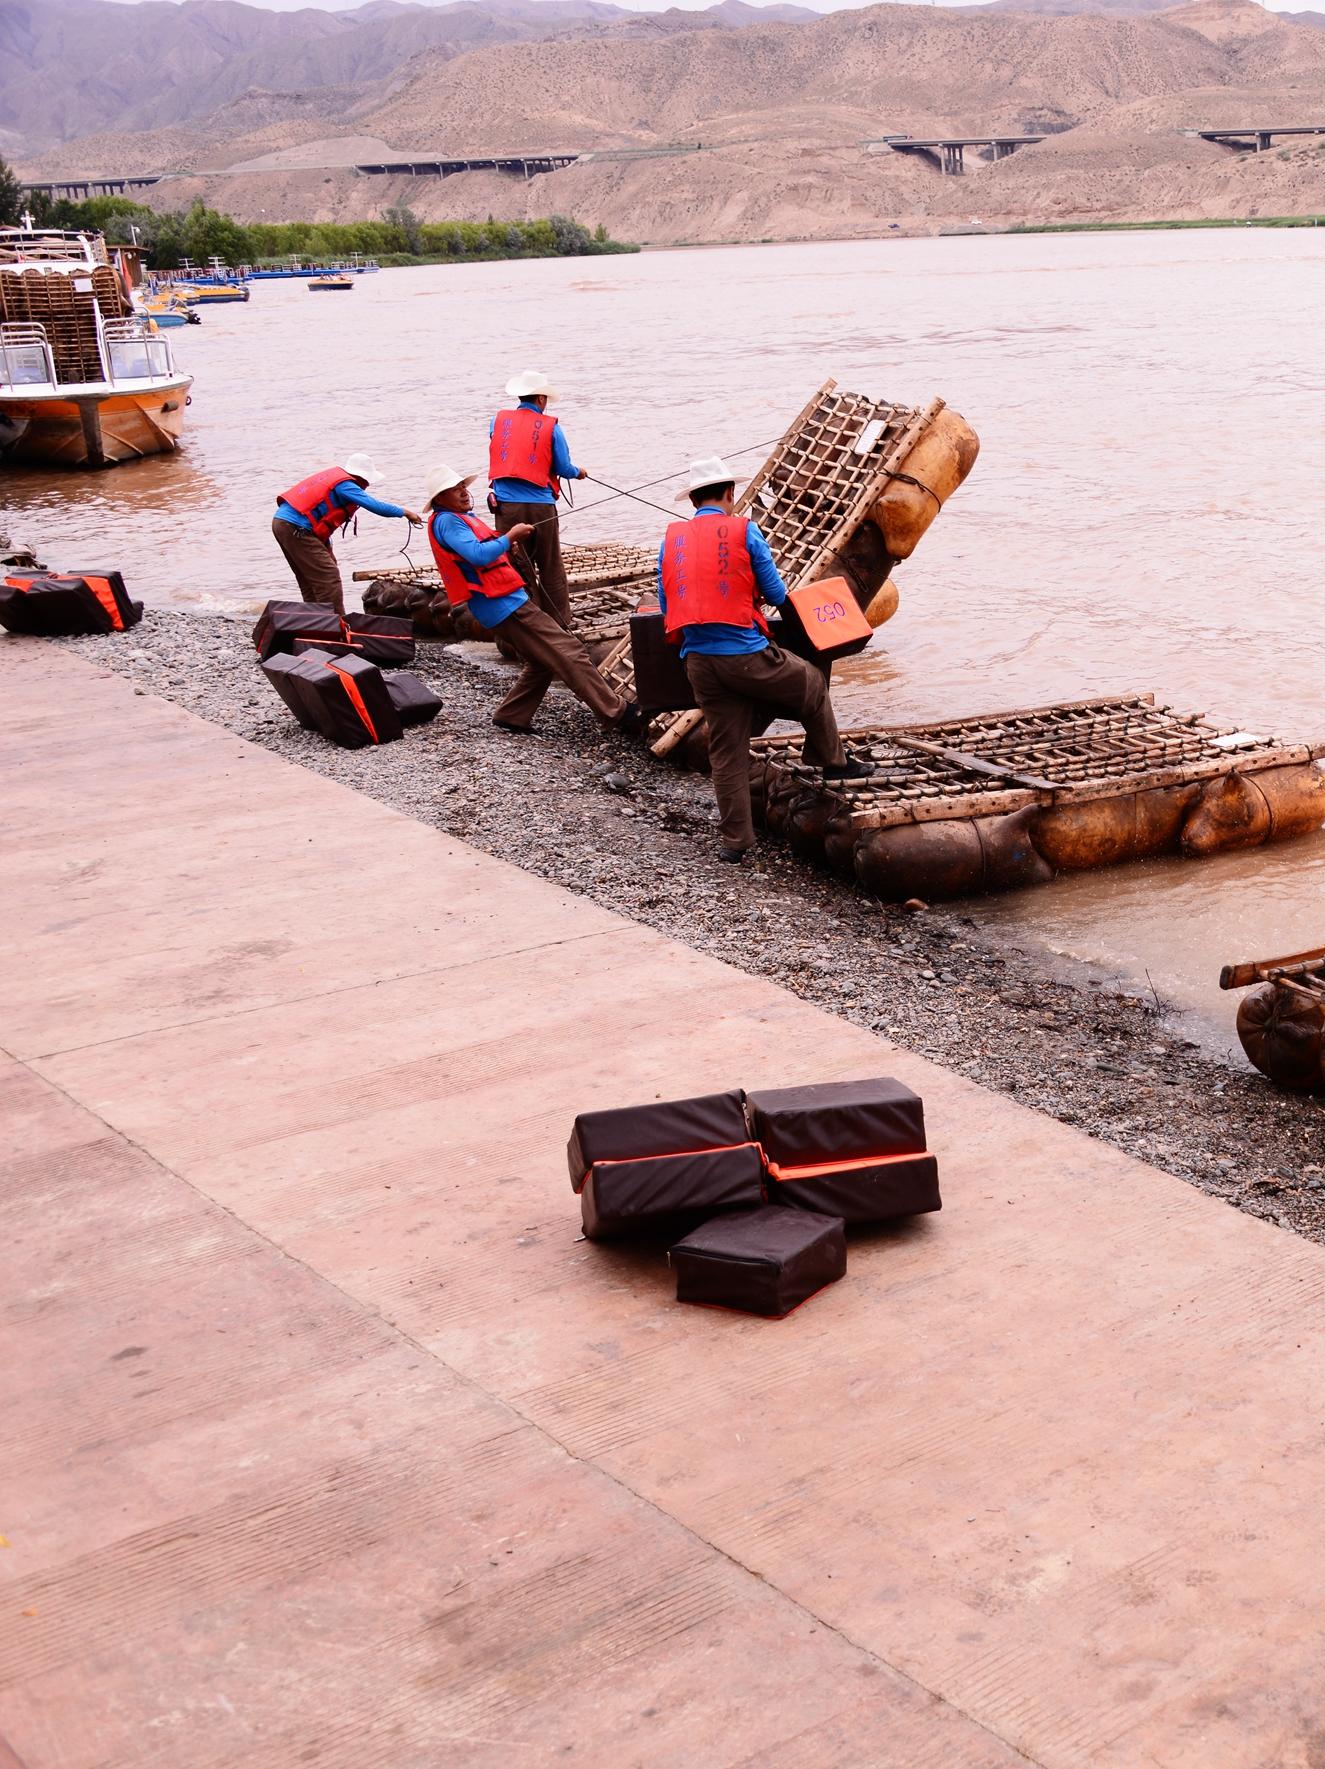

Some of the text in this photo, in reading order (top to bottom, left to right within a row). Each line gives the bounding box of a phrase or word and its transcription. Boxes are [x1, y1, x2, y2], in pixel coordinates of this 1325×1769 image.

[673, 535, 688, 600] 服务工号
[813, 602, 846, 623] 052
